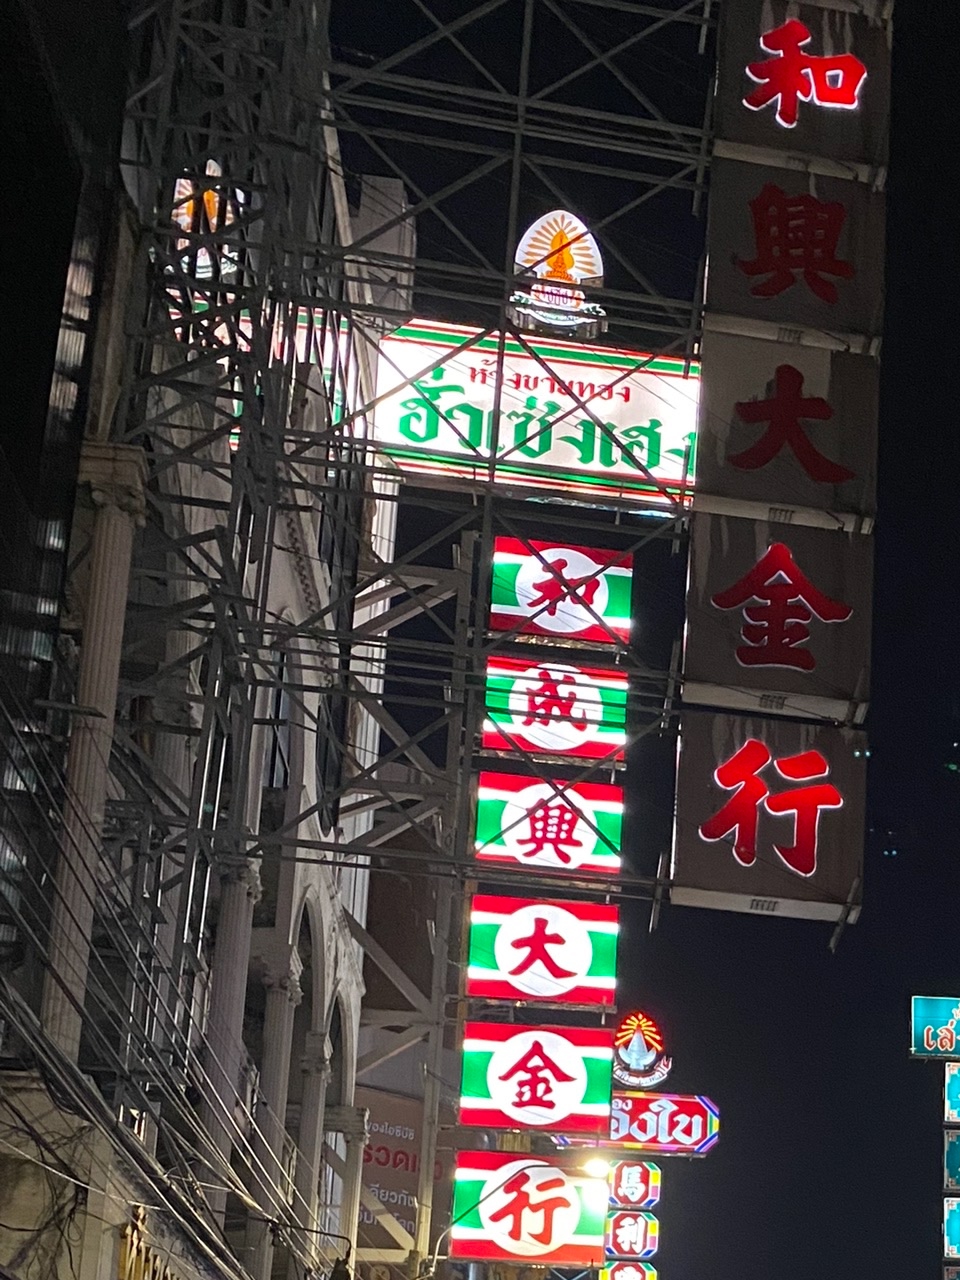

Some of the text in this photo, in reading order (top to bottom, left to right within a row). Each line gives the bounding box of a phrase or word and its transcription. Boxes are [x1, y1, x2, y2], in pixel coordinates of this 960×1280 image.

[699, 17, 868, 877] 和興大金行
